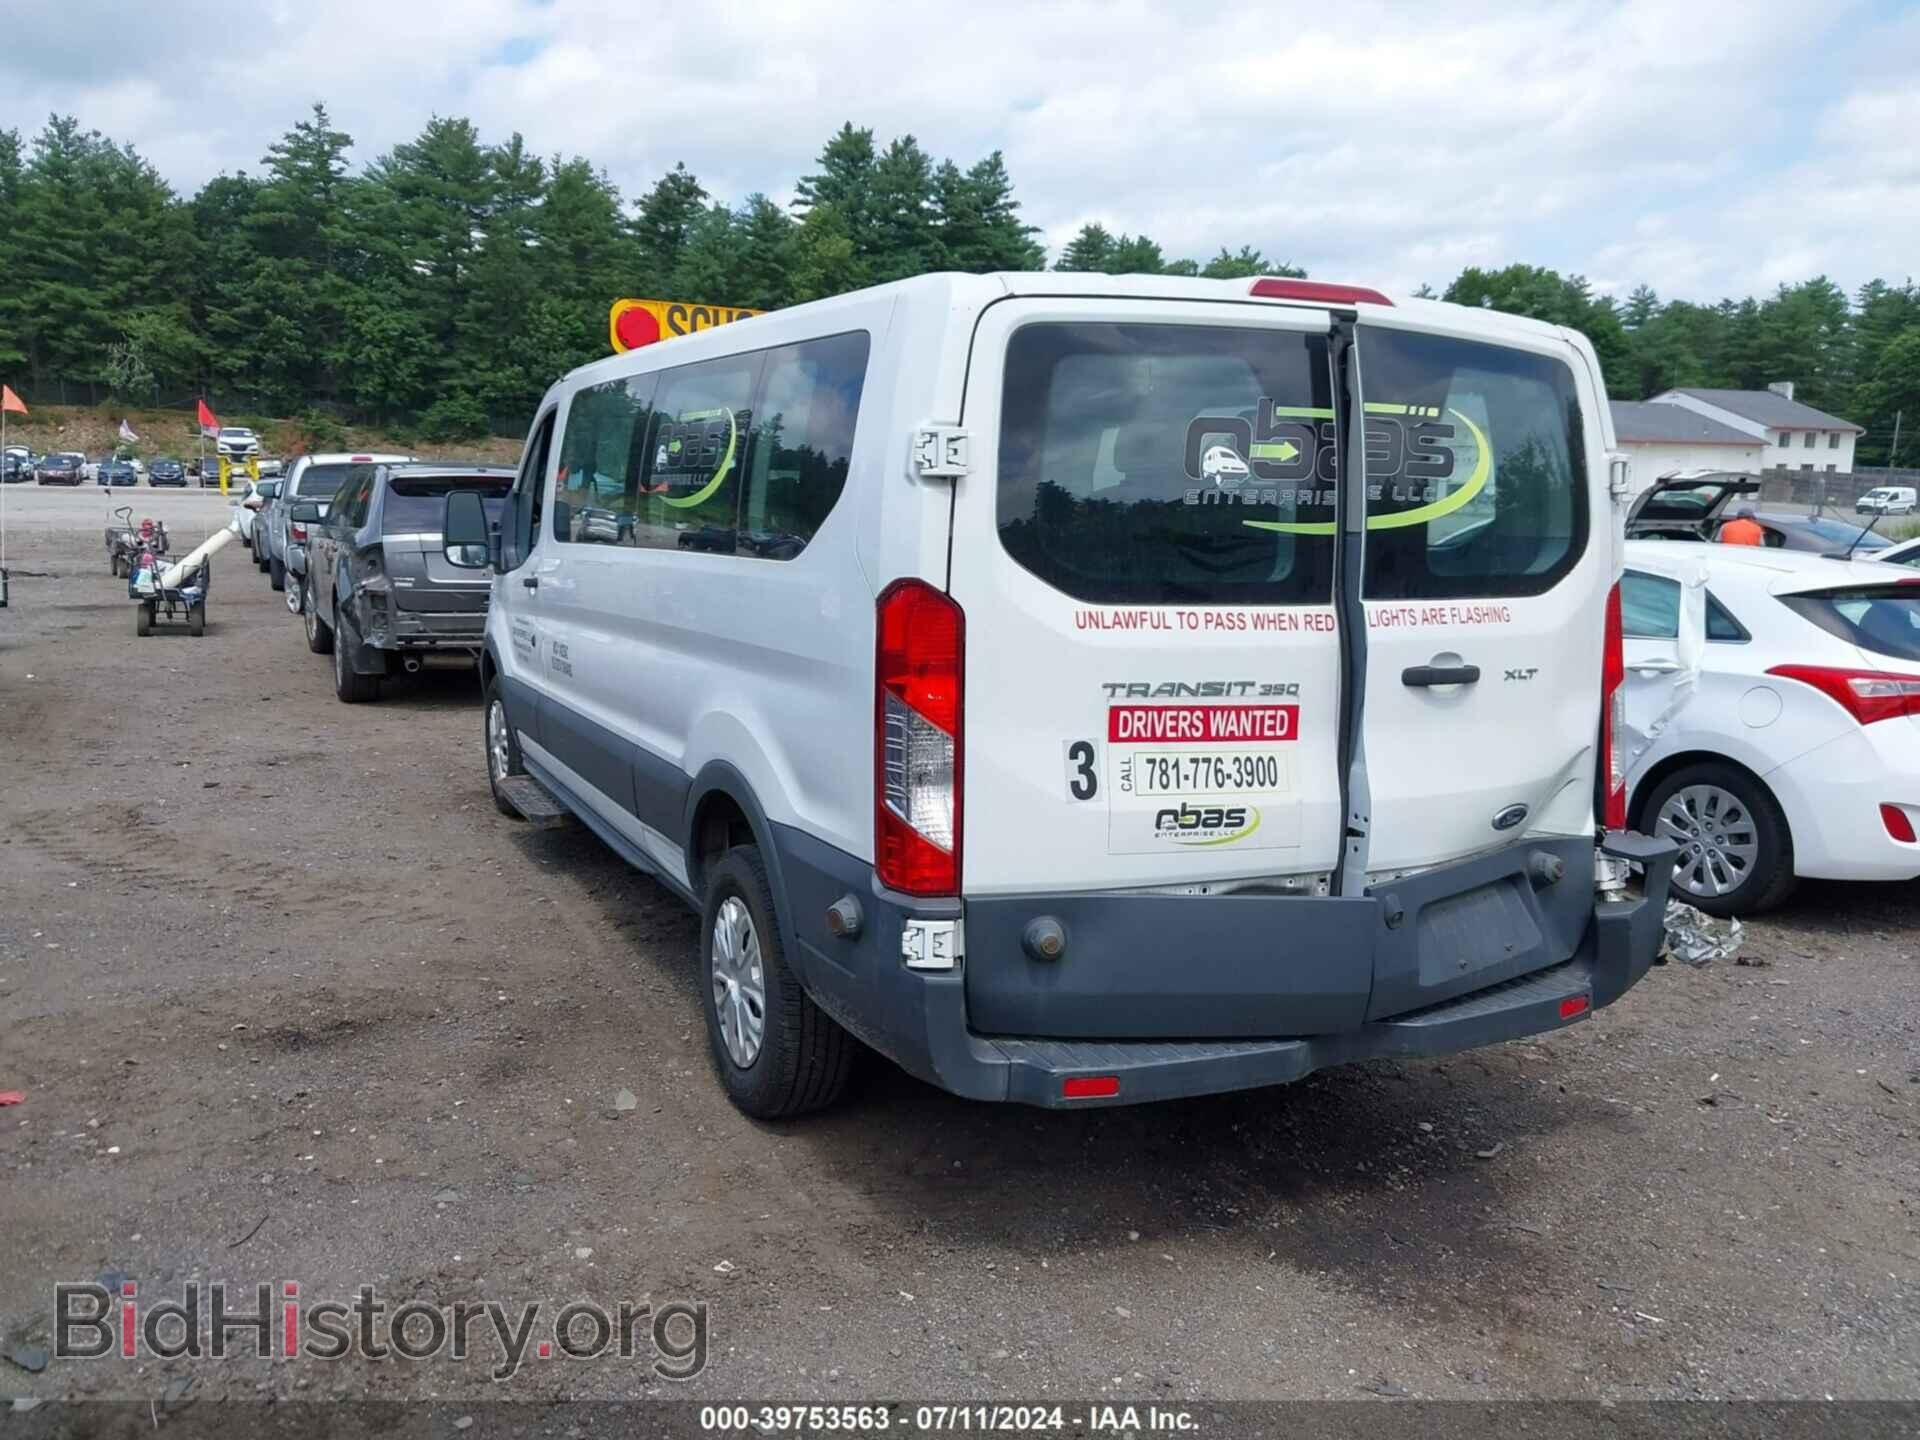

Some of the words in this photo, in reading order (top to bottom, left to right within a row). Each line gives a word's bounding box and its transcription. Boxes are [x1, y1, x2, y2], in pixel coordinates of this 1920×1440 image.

[1074, 610, 1172, 630] UNLAWFUL
[1176, 611, 1199, 630] TO
[1204, 612, 1247, 630] PASS
[1251, 613, 1299, 631] WHEN
[1304, 613, 1335, 632] RED
[1367, 608, 1417, 628] LIGHTS
[1421, 607, 1448, 626] ARE
[1450, 606, 1512, 625] FLASHING
[1101, 681, 1256, 698] TRANSIT
[1258, 683, 1300, 696] 350
[1503, 668, 1539, 682] XLT
[1118, 709, 1204, 738] DRIVERS
[1209, 709, 1289, 737] WANTED
[1068, 740, 1098, 801] 3
[1120, 757, 1132, 792] CALL
[1145, 756, 1278, 790] 781-776-3900
